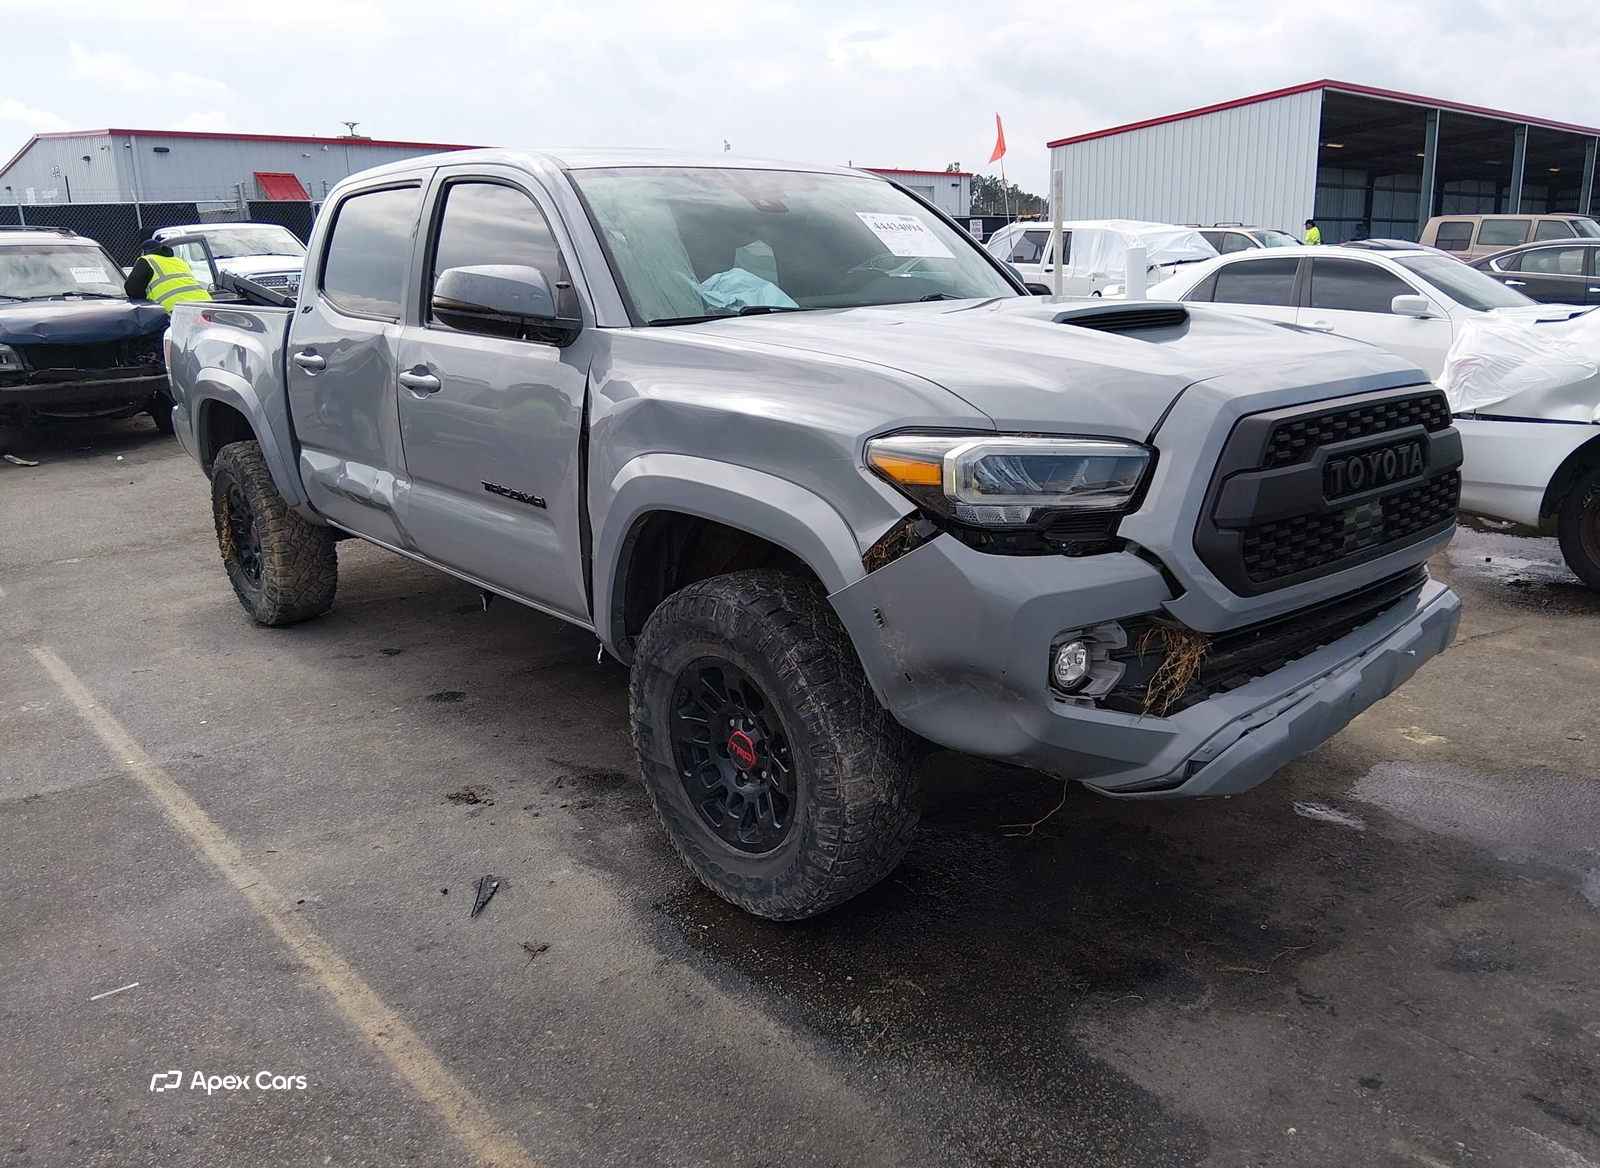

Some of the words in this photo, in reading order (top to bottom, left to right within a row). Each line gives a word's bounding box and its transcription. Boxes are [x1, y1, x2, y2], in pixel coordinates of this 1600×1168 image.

[1328, 442, 1423, 494] TOYOTA
[480, 479, 547, 509] TACOMA
[731, 741, 752, 761] TRD
